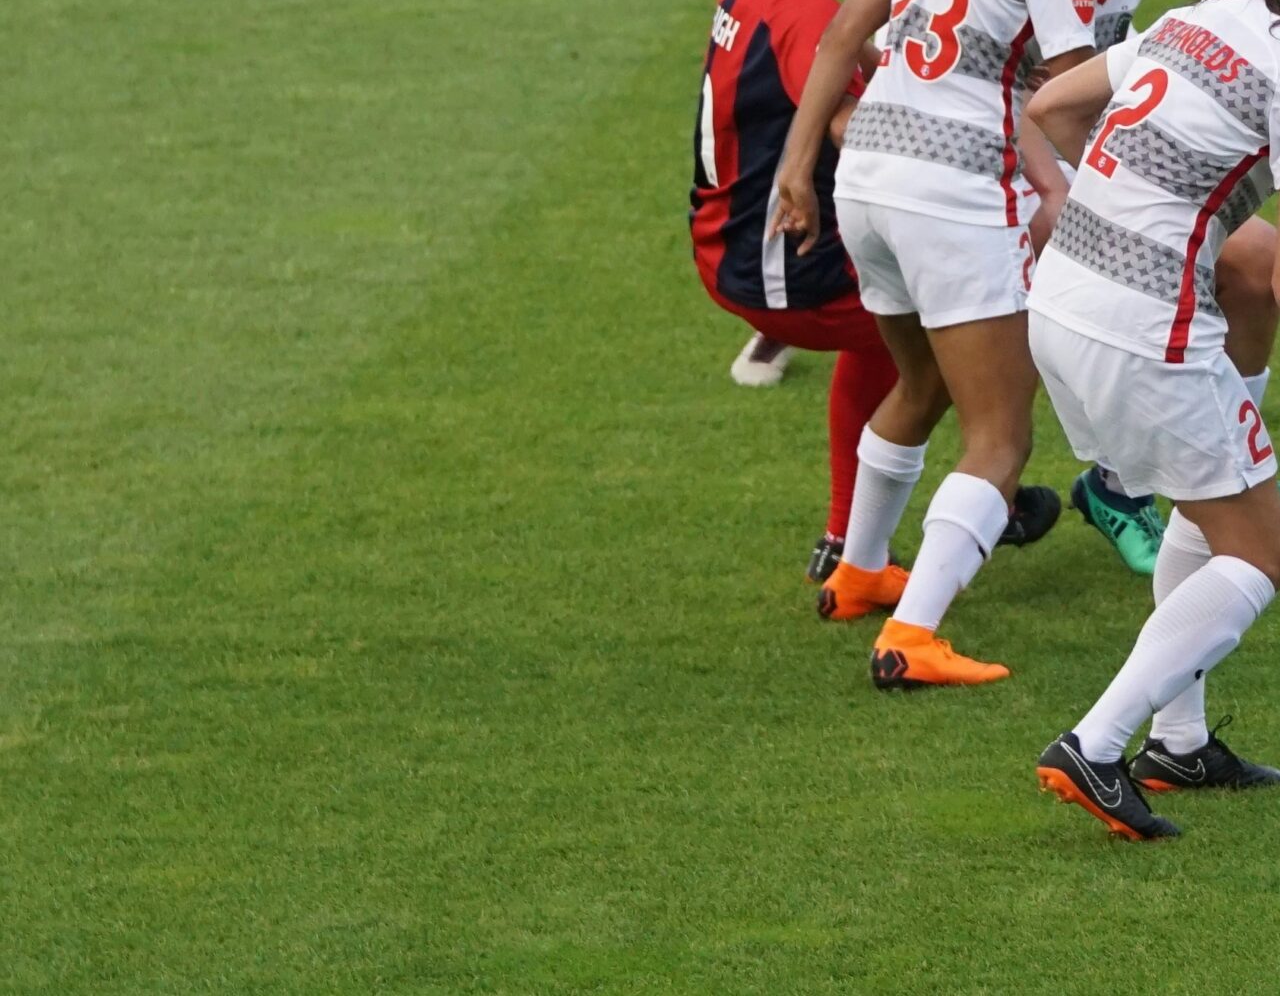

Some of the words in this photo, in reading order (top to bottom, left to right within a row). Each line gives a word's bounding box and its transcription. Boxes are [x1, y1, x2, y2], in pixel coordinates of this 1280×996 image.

[711, 5, 741, 52] UGH
[1085, 67, 1168, 179] 2
[1238, 399, 1273, 465] 2
